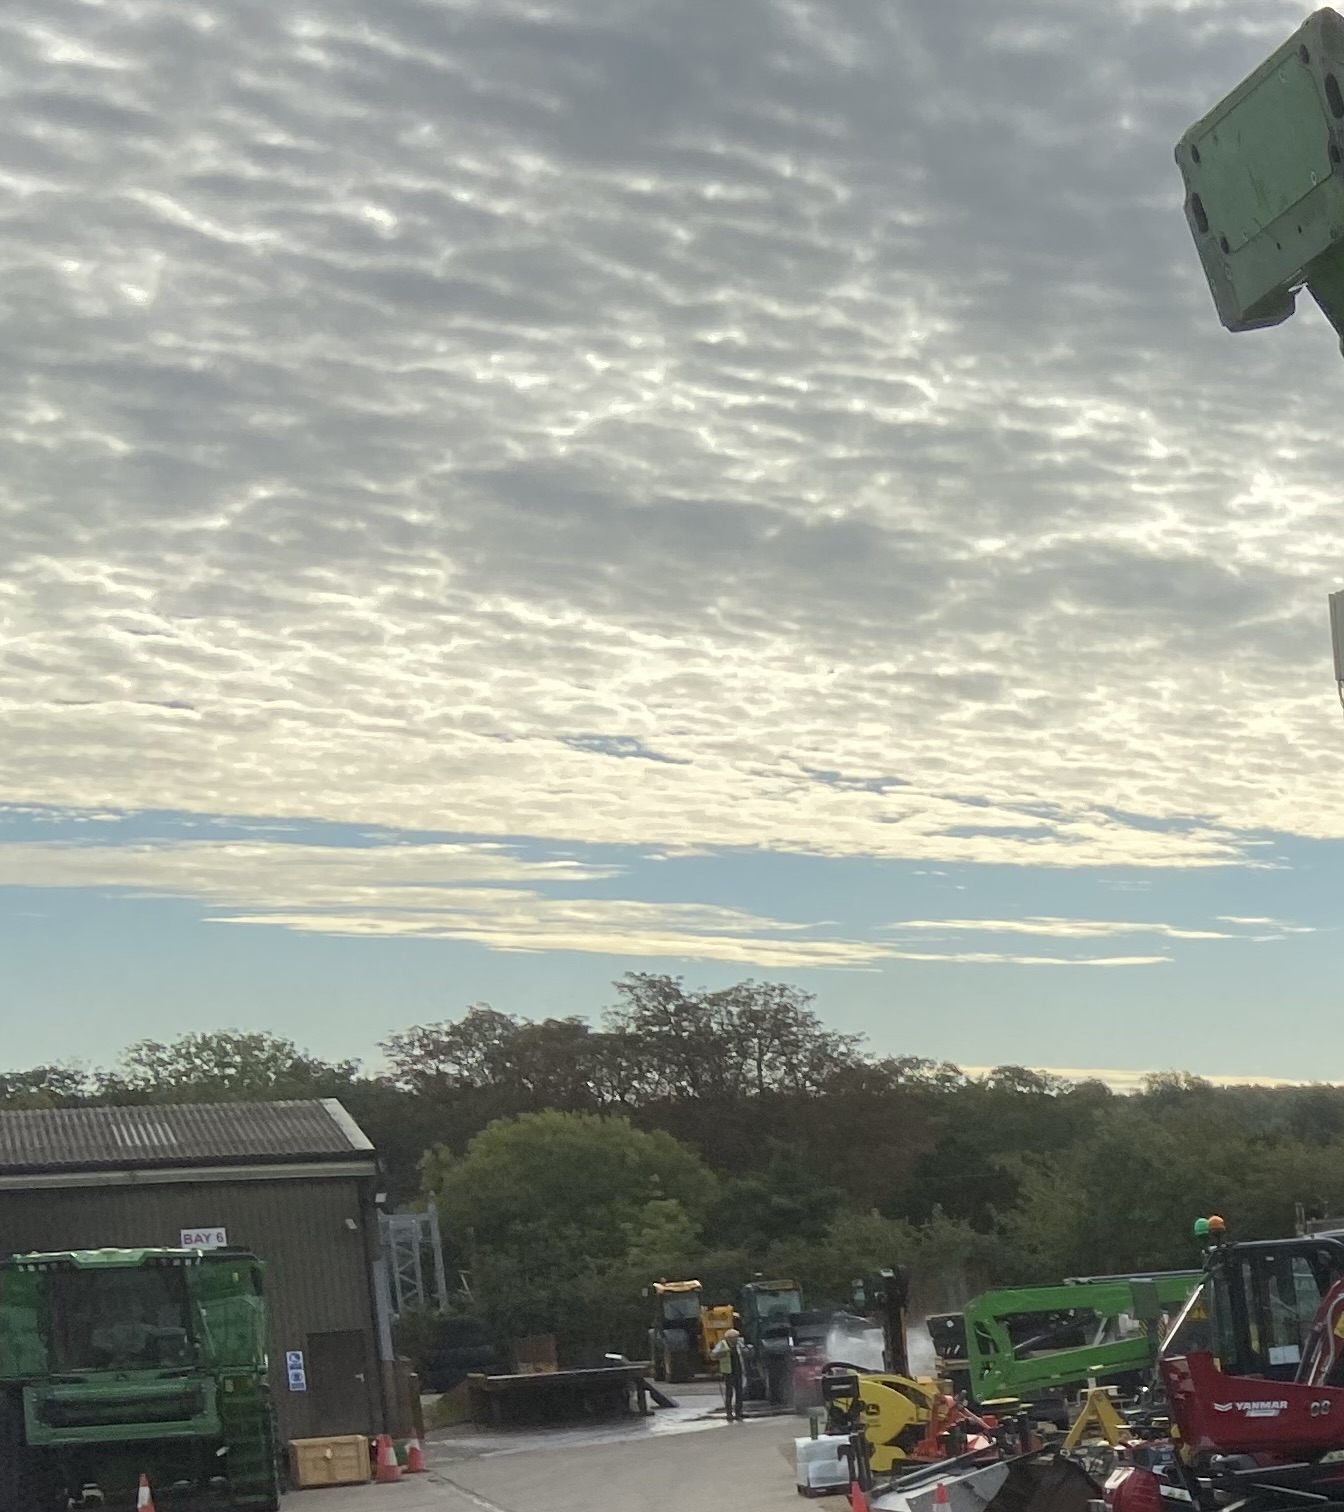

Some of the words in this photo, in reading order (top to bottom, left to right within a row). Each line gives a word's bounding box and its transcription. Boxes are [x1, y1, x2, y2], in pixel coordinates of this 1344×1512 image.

[183, 1233, 211, 1245] BAY
[216, 1232, 225, 1243] 6
[1234, 1400, 1288, 1411] YANMAR
